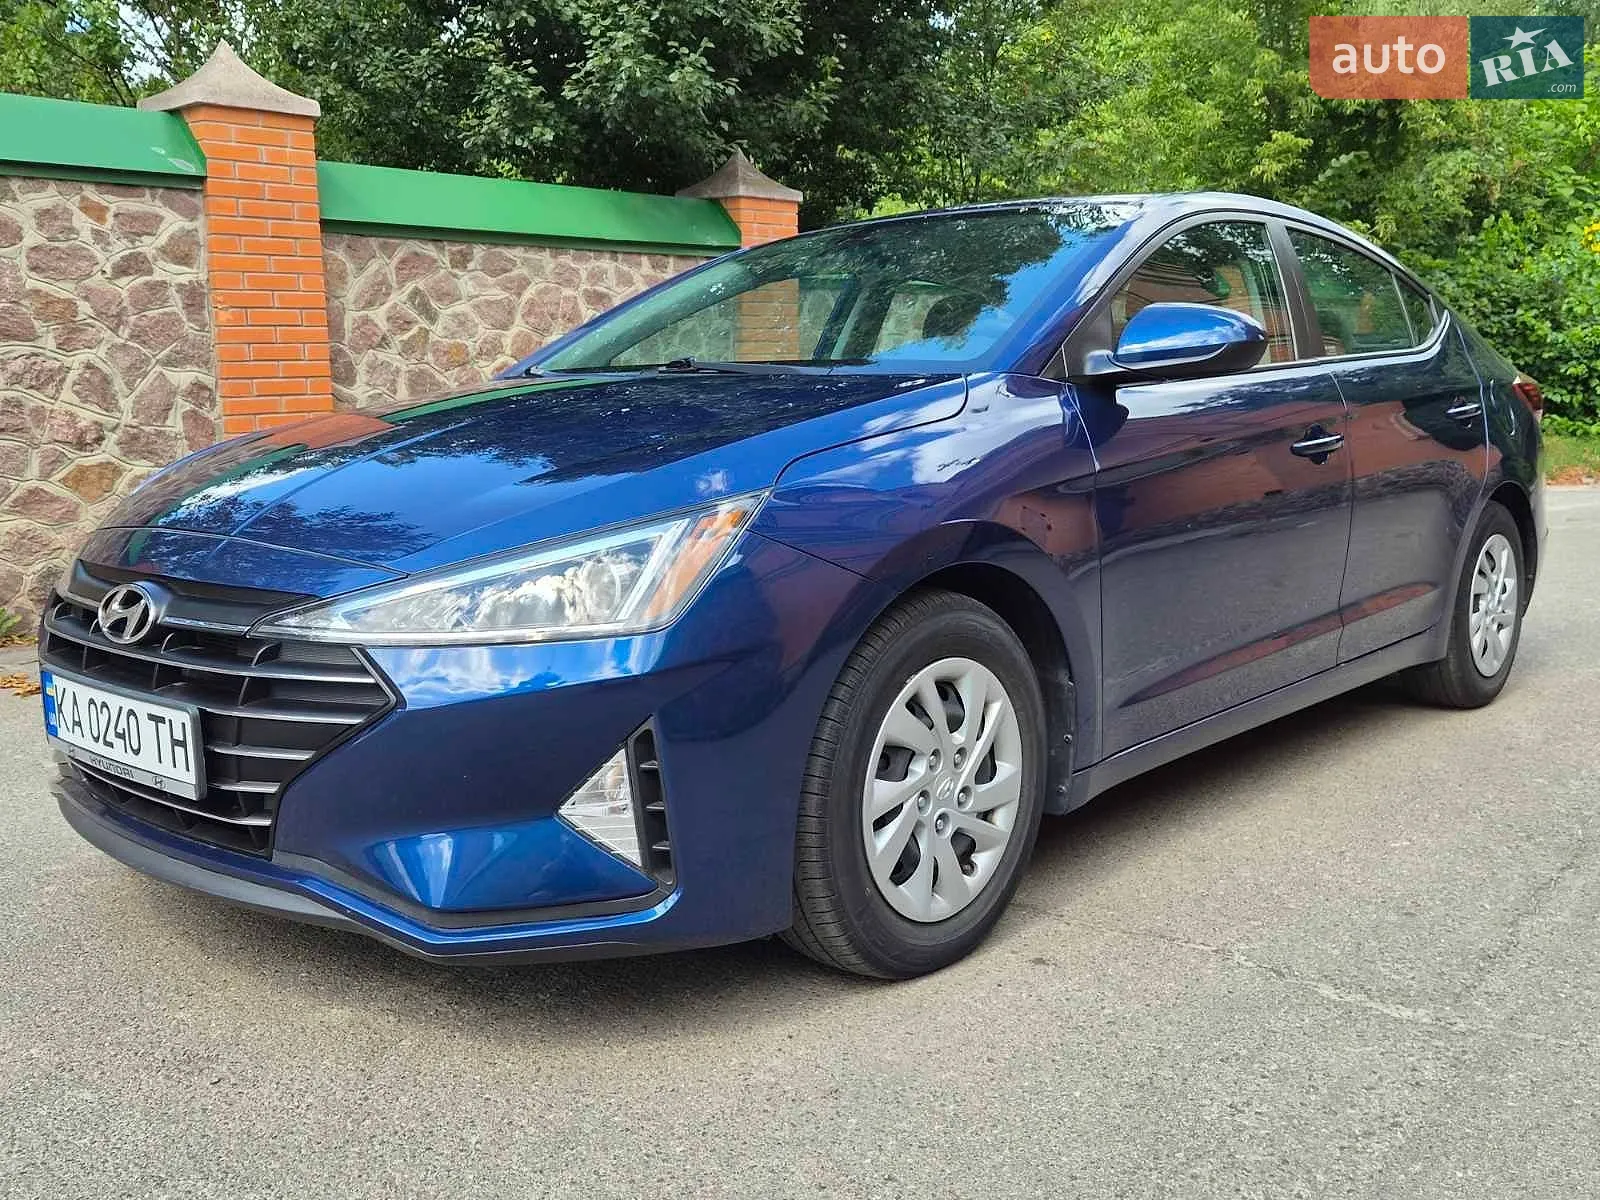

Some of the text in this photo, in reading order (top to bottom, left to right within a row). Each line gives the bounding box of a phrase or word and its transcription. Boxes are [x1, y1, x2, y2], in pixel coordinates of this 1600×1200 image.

[54, 684, 190, 772] KA 0240 TH
